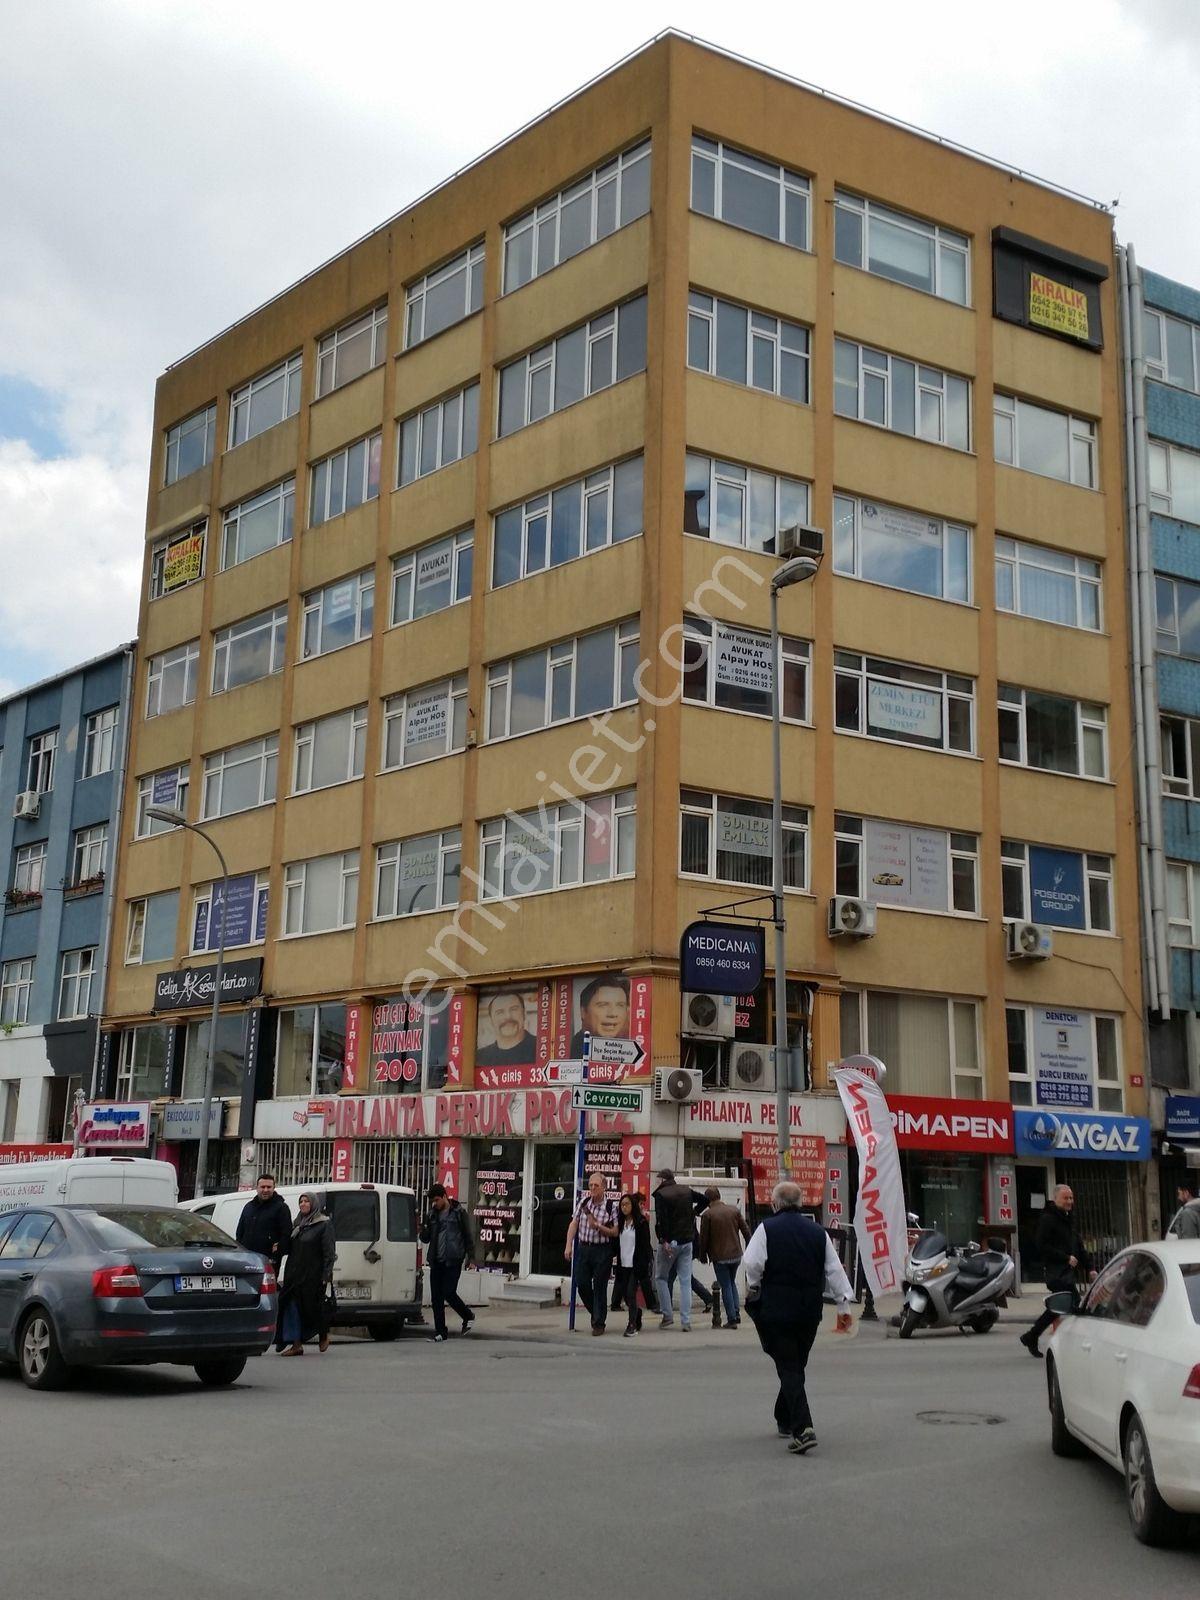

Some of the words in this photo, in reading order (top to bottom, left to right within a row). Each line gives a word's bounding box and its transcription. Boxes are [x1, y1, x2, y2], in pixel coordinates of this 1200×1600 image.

[420, 553, 450, 573] AVUKAT
[731, 645, 764, 658] AVUKAT
[720, 653, 750, 667] Alpay
[416, 704, 439, 716] AVUKAT
[408, 716, 429, 727] Alpay
[1033, 889, 1081, 903] POSEIDON
[1041, 899, 1075, 911] GROUP
[688, 936, 751, 953] MEDICANA
[696, 957, 715, 967] 0850
[717, 959, 731, 968] 460
[732, 961, 750, 970] 6334
[158, 977, 178, 996] Gelin
[541, 987, 549, 1030] PROTEZ
[559, 985, 568, 1029] PROTEZ
[348, 1010, 358, 1063] GİRİŞ
[451, 1002, 462, 1058] GİRİŞ
[373, 1029, 422, 1054] KAYNAK
[539, 1037, 547, 1059] SAÇ
[558, 1036, 566, 1059] SAÇ
[375, 1058, 418, 1082] 200
[501, 1071, 522, 1082] GİRİŞ
[589, 1064, 613, 1080] GİRİŞ
[1039, 1069, 1061, 1079] BURCU
[1063, 1072, 1088, 1081] ERENAY
[585, 1091, 639, 1107] Çevreyolu
[323, 1095, 426, 1136] PIRLANTA
[435, 1091, 513, 1135] PERUK
[690, 1100, 752, 1123] PIRLANTA
[761, 1104, 802, 1127] PEUK
[751, 1134, 803, 1147] PİMAEN
[1057, 1122, 1140, 1152] AYGAZ
[607, 1153, 620, 1162] FÖN
[751, 1146, 819, 1158] KAMANYA
[482, 1182, 495, 1195] 40
[497, 1182, 508, 1195] TL
[480, 1229, 493, 1241] 30
[494, 1230, 505, 1242] TL
[182, 1278, 193, 1289] 34
[220, 1277, 234, 1288] 191
